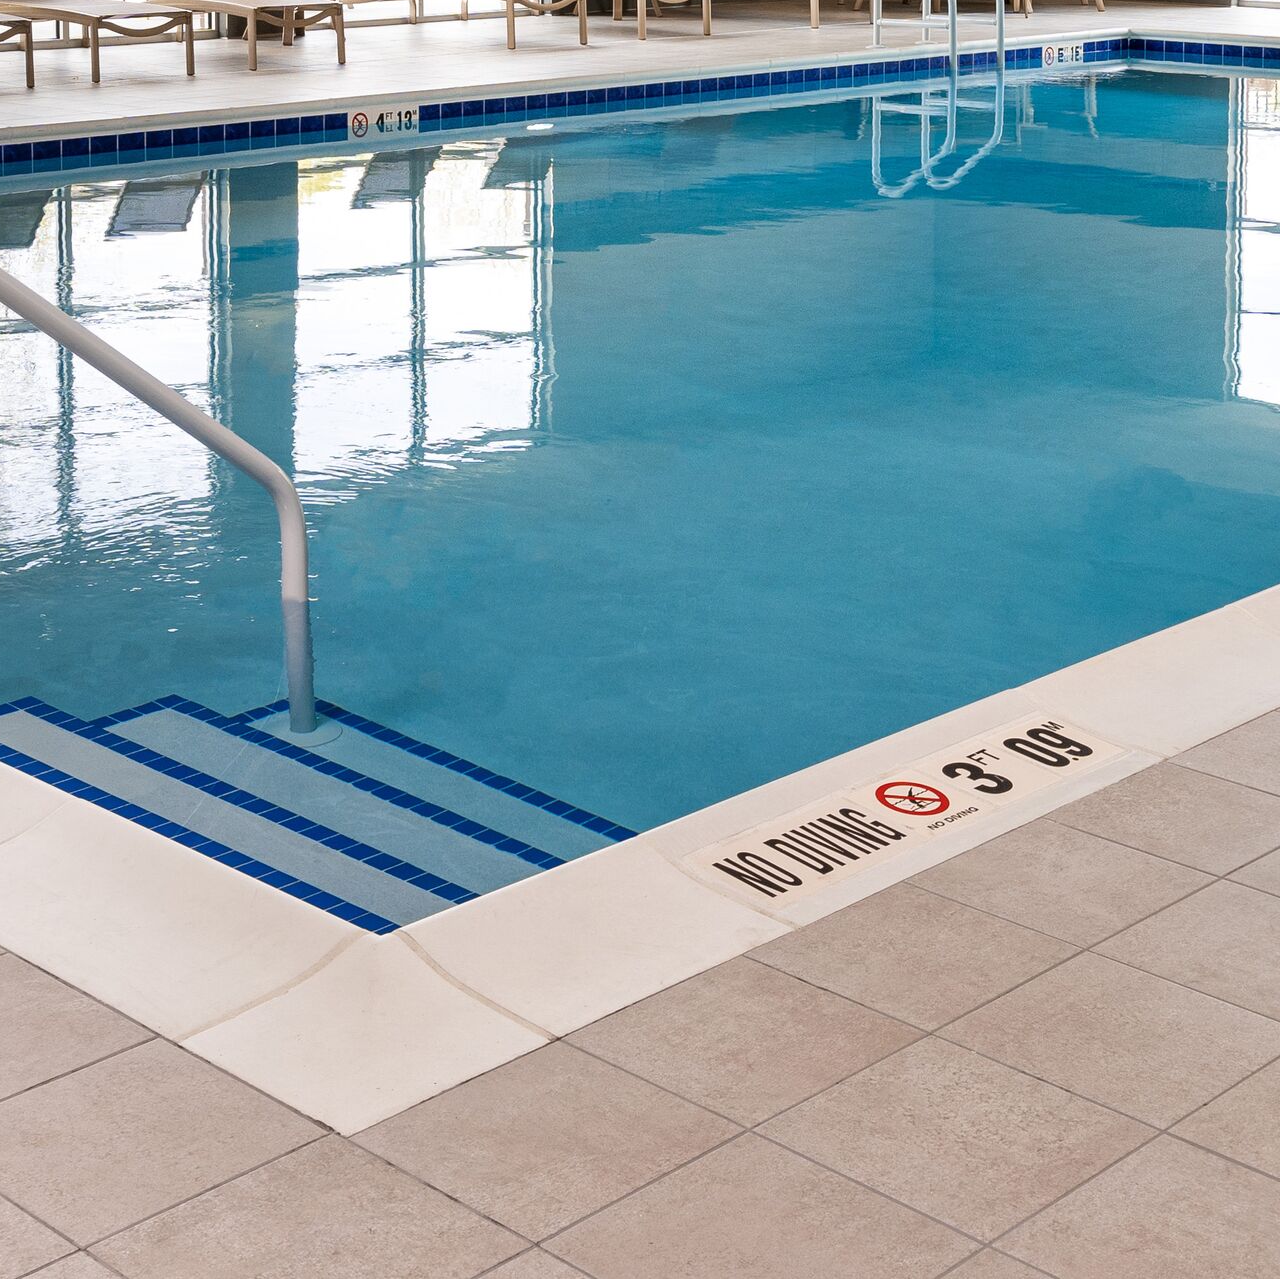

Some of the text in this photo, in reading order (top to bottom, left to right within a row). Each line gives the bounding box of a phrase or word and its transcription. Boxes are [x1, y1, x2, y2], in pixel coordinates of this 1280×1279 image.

[385, 112, 393, 120] FT
[1041, 720, 1065, 732] M
[966, 749, 1000, 766] FT
[941, 762, 1013, 794] 3
[927, 806, 980, 831] NO DIVING
[712, 808, 907, 898] NO DIVING
